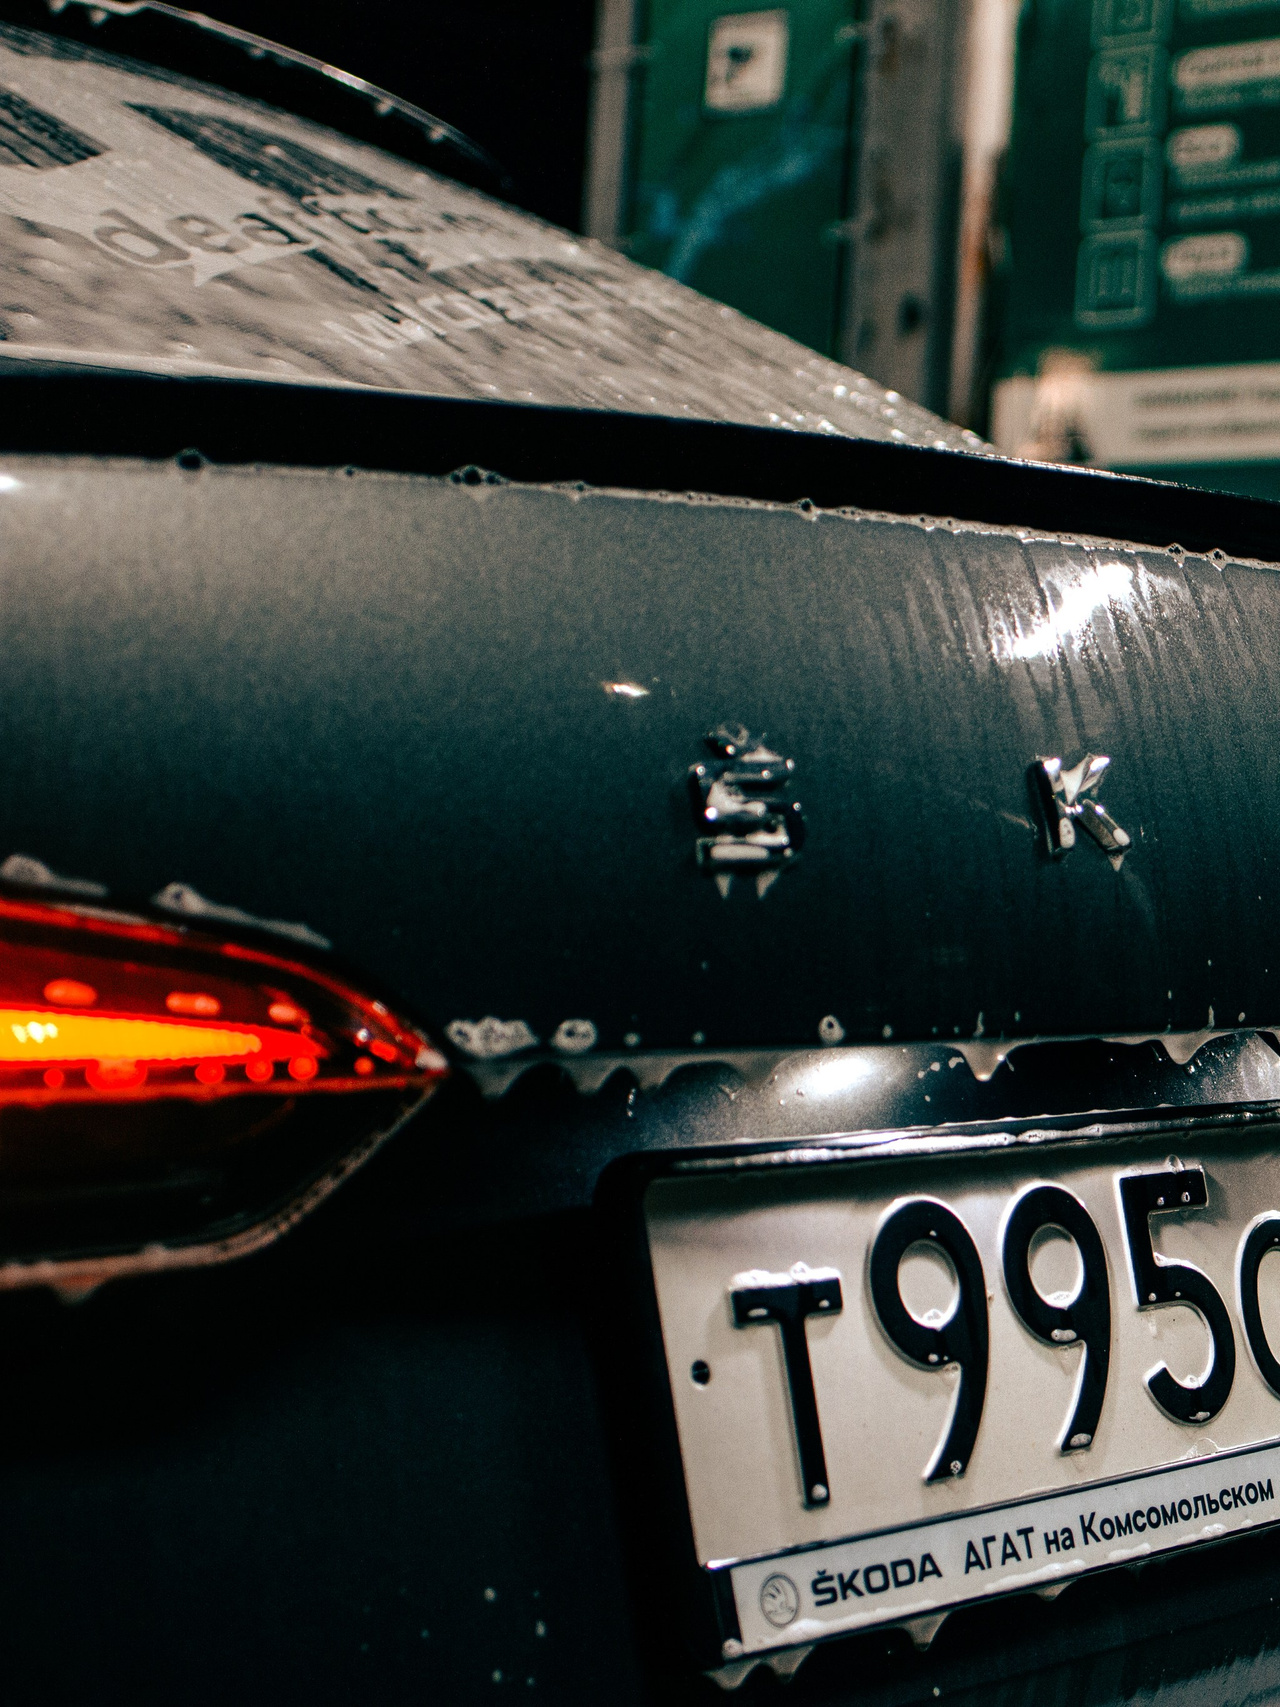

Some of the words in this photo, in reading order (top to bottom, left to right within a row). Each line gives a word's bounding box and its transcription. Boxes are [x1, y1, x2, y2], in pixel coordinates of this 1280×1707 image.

[810, 1552, 943, 1608] ŠKODA
[964, 1527, 1035, 1575] АГАТ
[1043, 1530, 1076, 1556] на
[1080, 1478, 1275, 1543] Комсомольском
